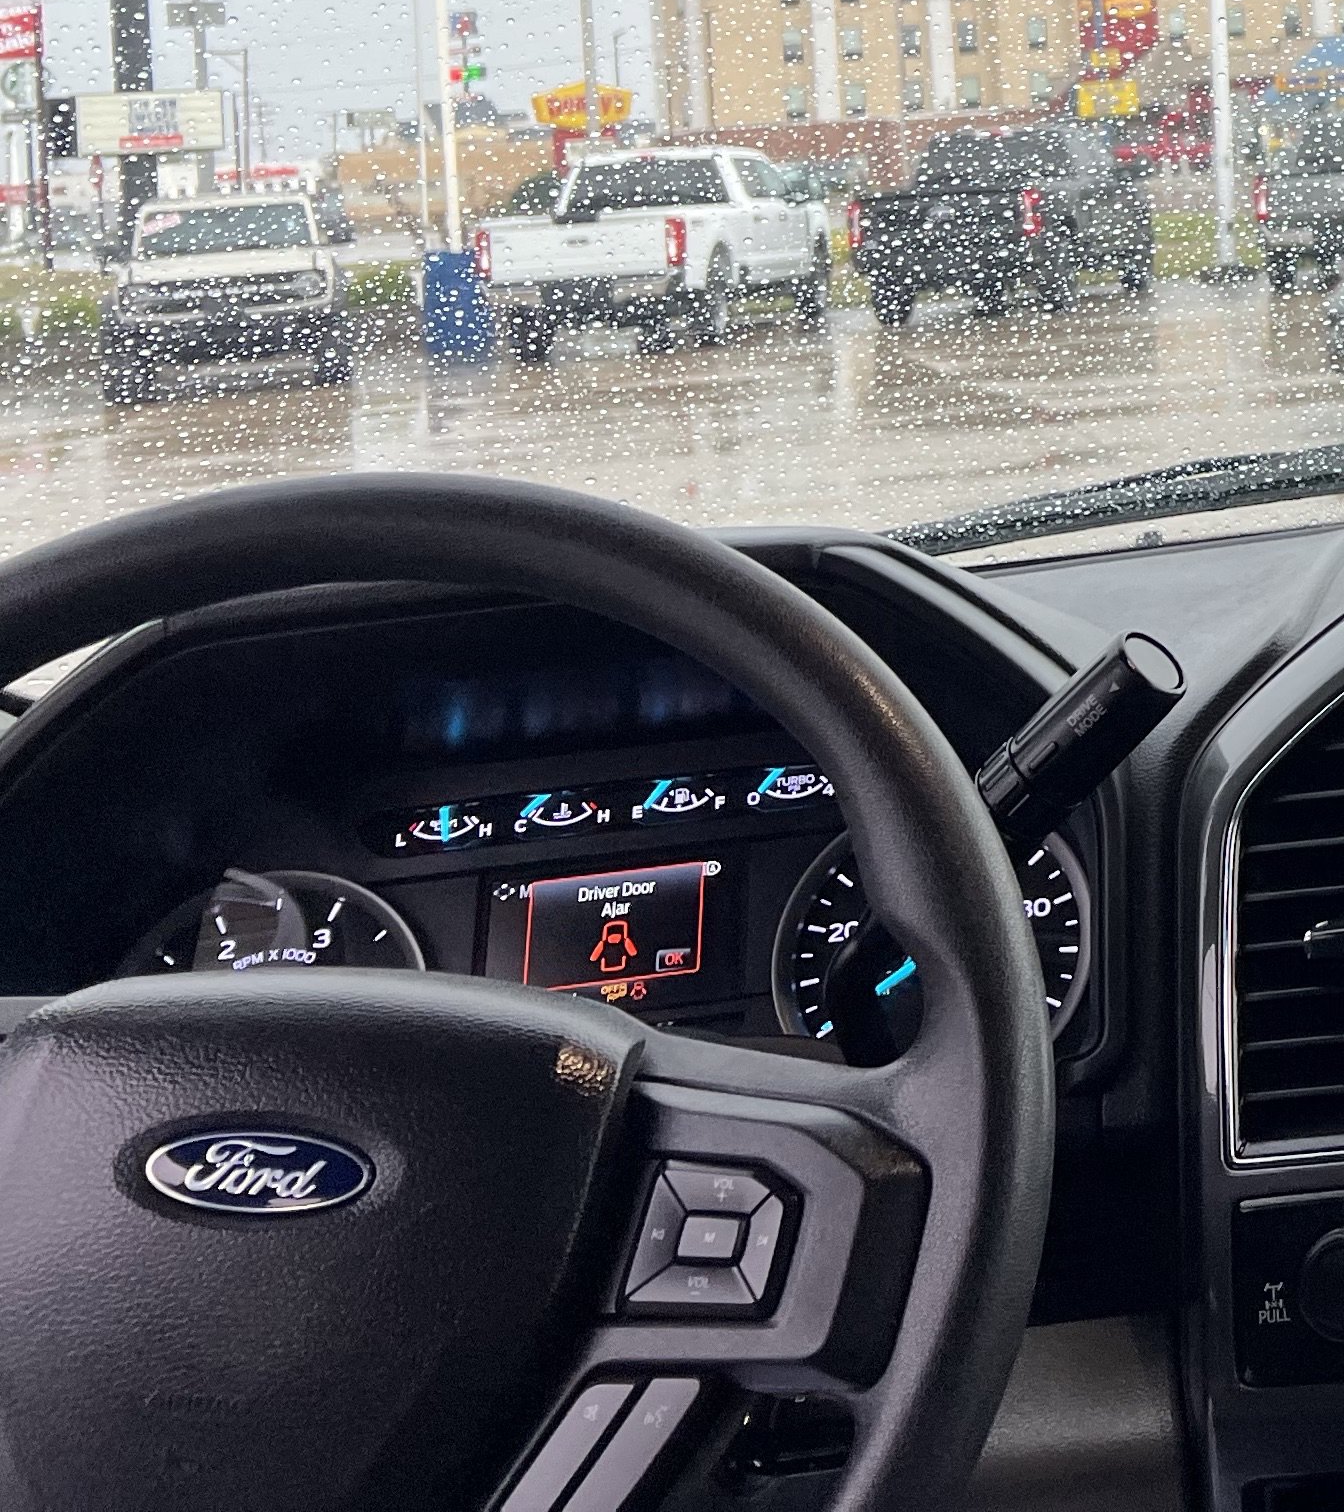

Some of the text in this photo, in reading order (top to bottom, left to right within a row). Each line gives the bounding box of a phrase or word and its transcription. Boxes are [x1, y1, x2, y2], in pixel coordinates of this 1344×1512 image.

[1066, 694, 1099, 728] DRIVE
[1074, 706, 1108, 737] MODE
[776, 773, 815, 788] TURBO
[715, 795, 727, 810] F
[597, 809, 611, 823] H
[632, 806, 644, 820] E
[478, 822, 493, 837] H
[514, 818, 528, 833] C
[395, 833, 407, 848] L
[577, 880, 657, 903] Driver Door
[601, 901, 632, 918] Ajar
[312, 928, 331, 948] 3
[217, 940, 236, 961] 2
[232, 950, 265, 970] RPM
[281, 947, 317, 964] 1000
[664, 952, 684, 966] OK
[184, 1139, 328, 1199] Ford
[713, 1178, 734, 1190] VOL
[1258, 1308, 1292, 1324] PULL
